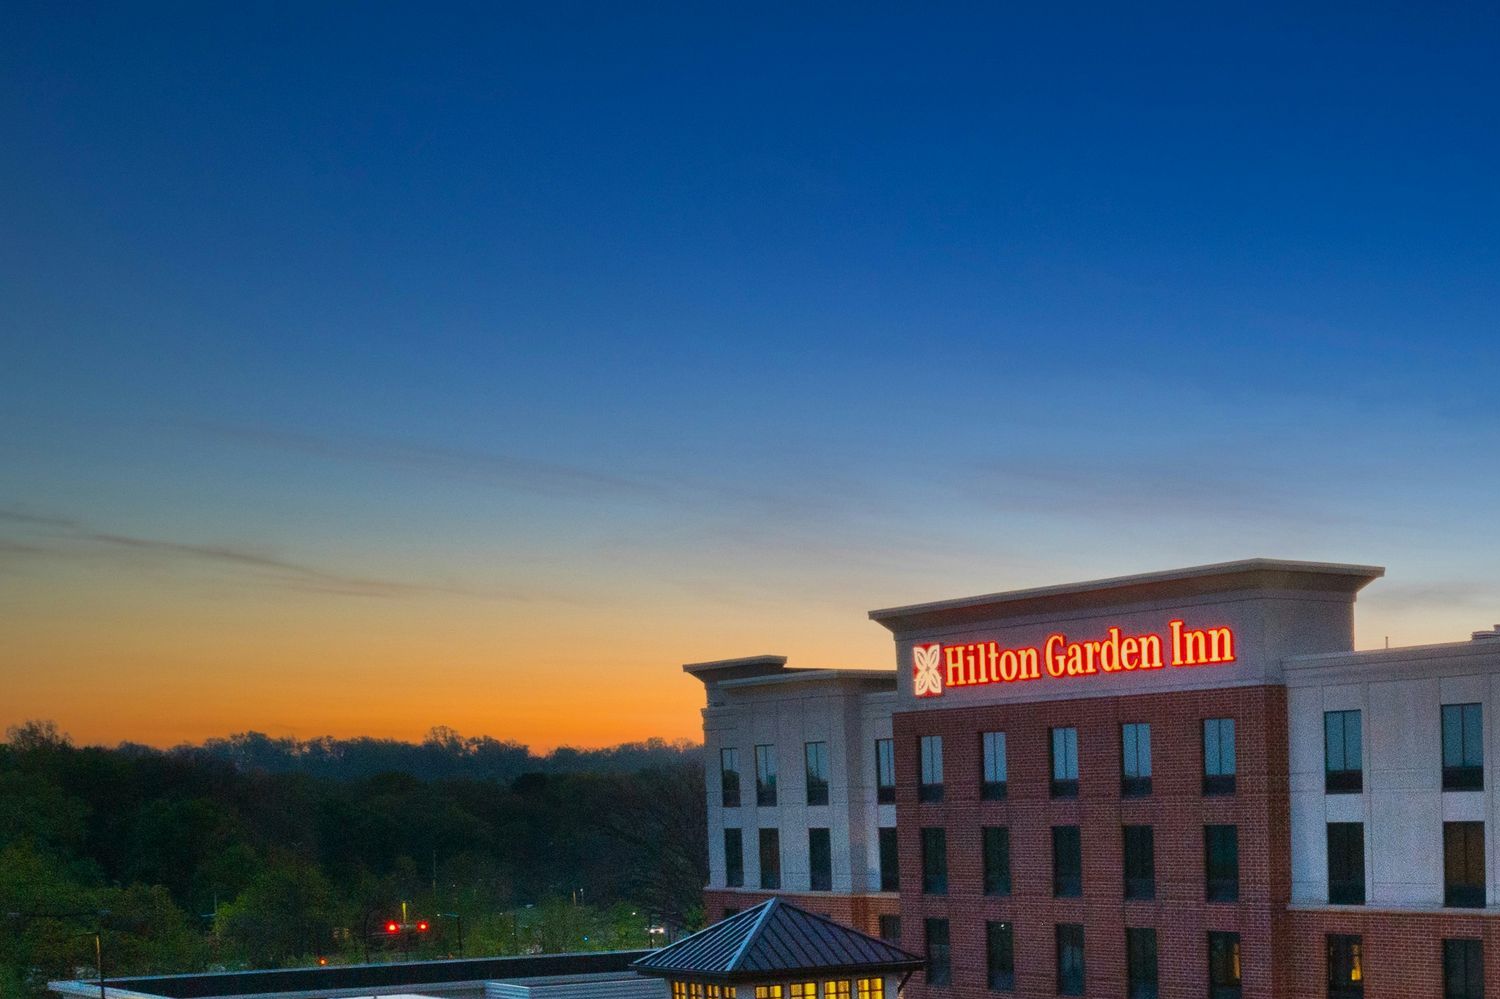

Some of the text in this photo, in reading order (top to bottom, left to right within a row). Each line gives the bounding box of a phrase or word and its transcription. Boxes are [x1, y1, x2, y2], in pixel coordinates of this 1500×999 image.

[944, 620, 1235, 687] Hilton Garden Inn
